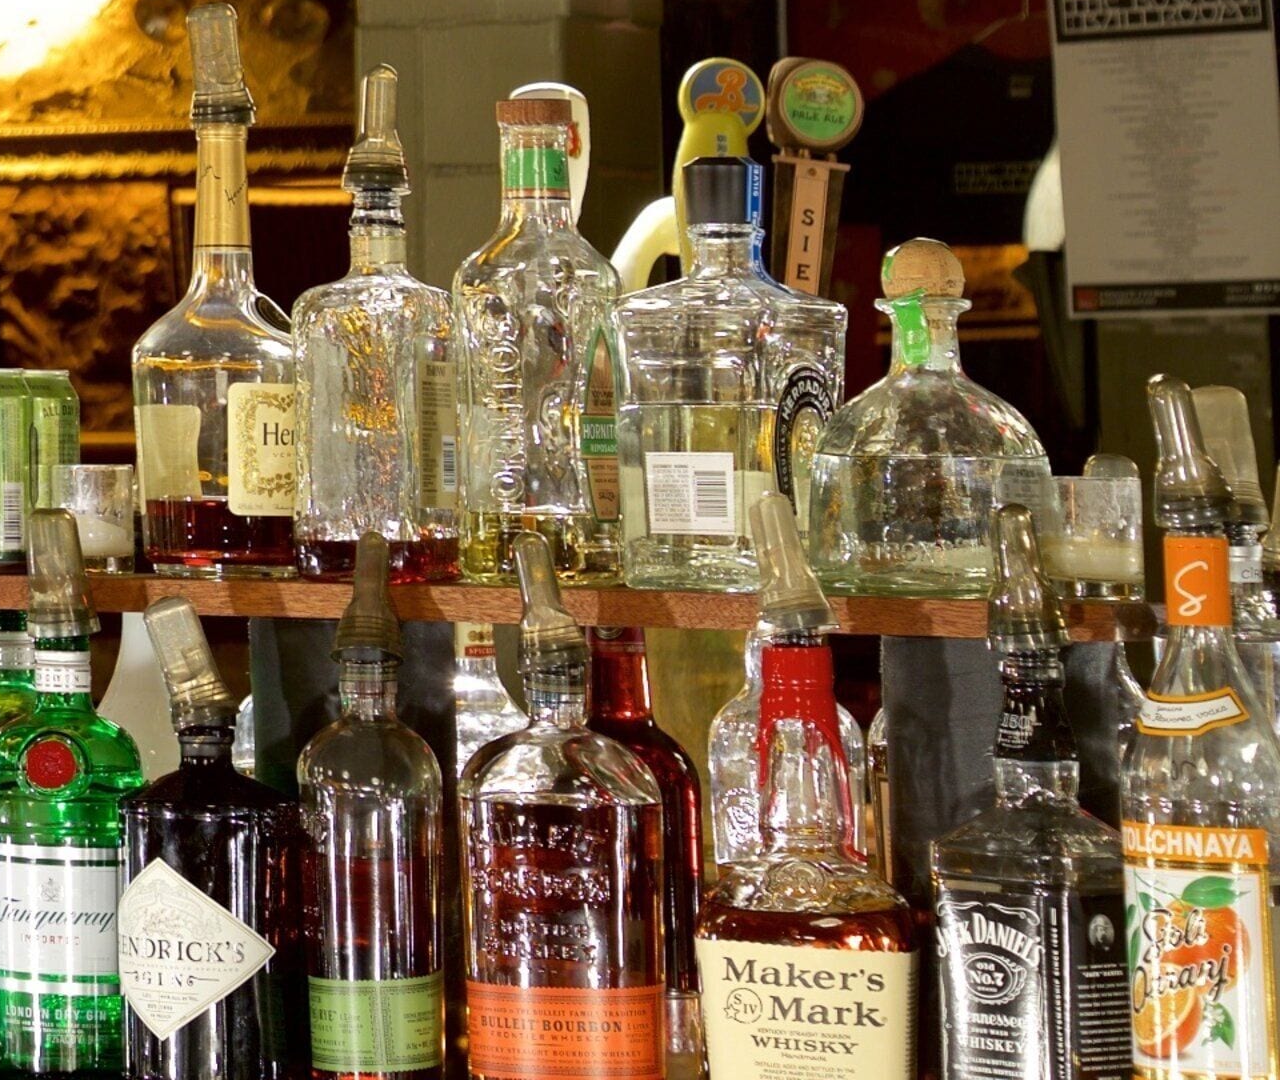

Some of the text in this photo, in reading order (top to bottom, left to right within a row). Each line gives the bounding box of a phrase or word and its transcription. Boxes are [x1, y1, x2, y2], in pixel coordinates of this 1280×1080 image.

[1174, 560, 1208, 616] S
[0, 898, 115, 933] Tanqueray
[119, 934, 246, 963] ENDRICK'S
[972, 913, 1045, 967] DANIEL'S
[722, 957, 886, 992] Maker's
[976, 962, 995, 971] Old
[87, 1010, 106, 1021] GIN
[744, 1004, 757, 1015] IV
[768, 996, 886, 1027] Mark
[481, 1016, 622, 1033] BULLEIT BOURBON
[751, 1035, 858, 1055] WHISKY
[781, 1052, 827, 1062] Handmade
